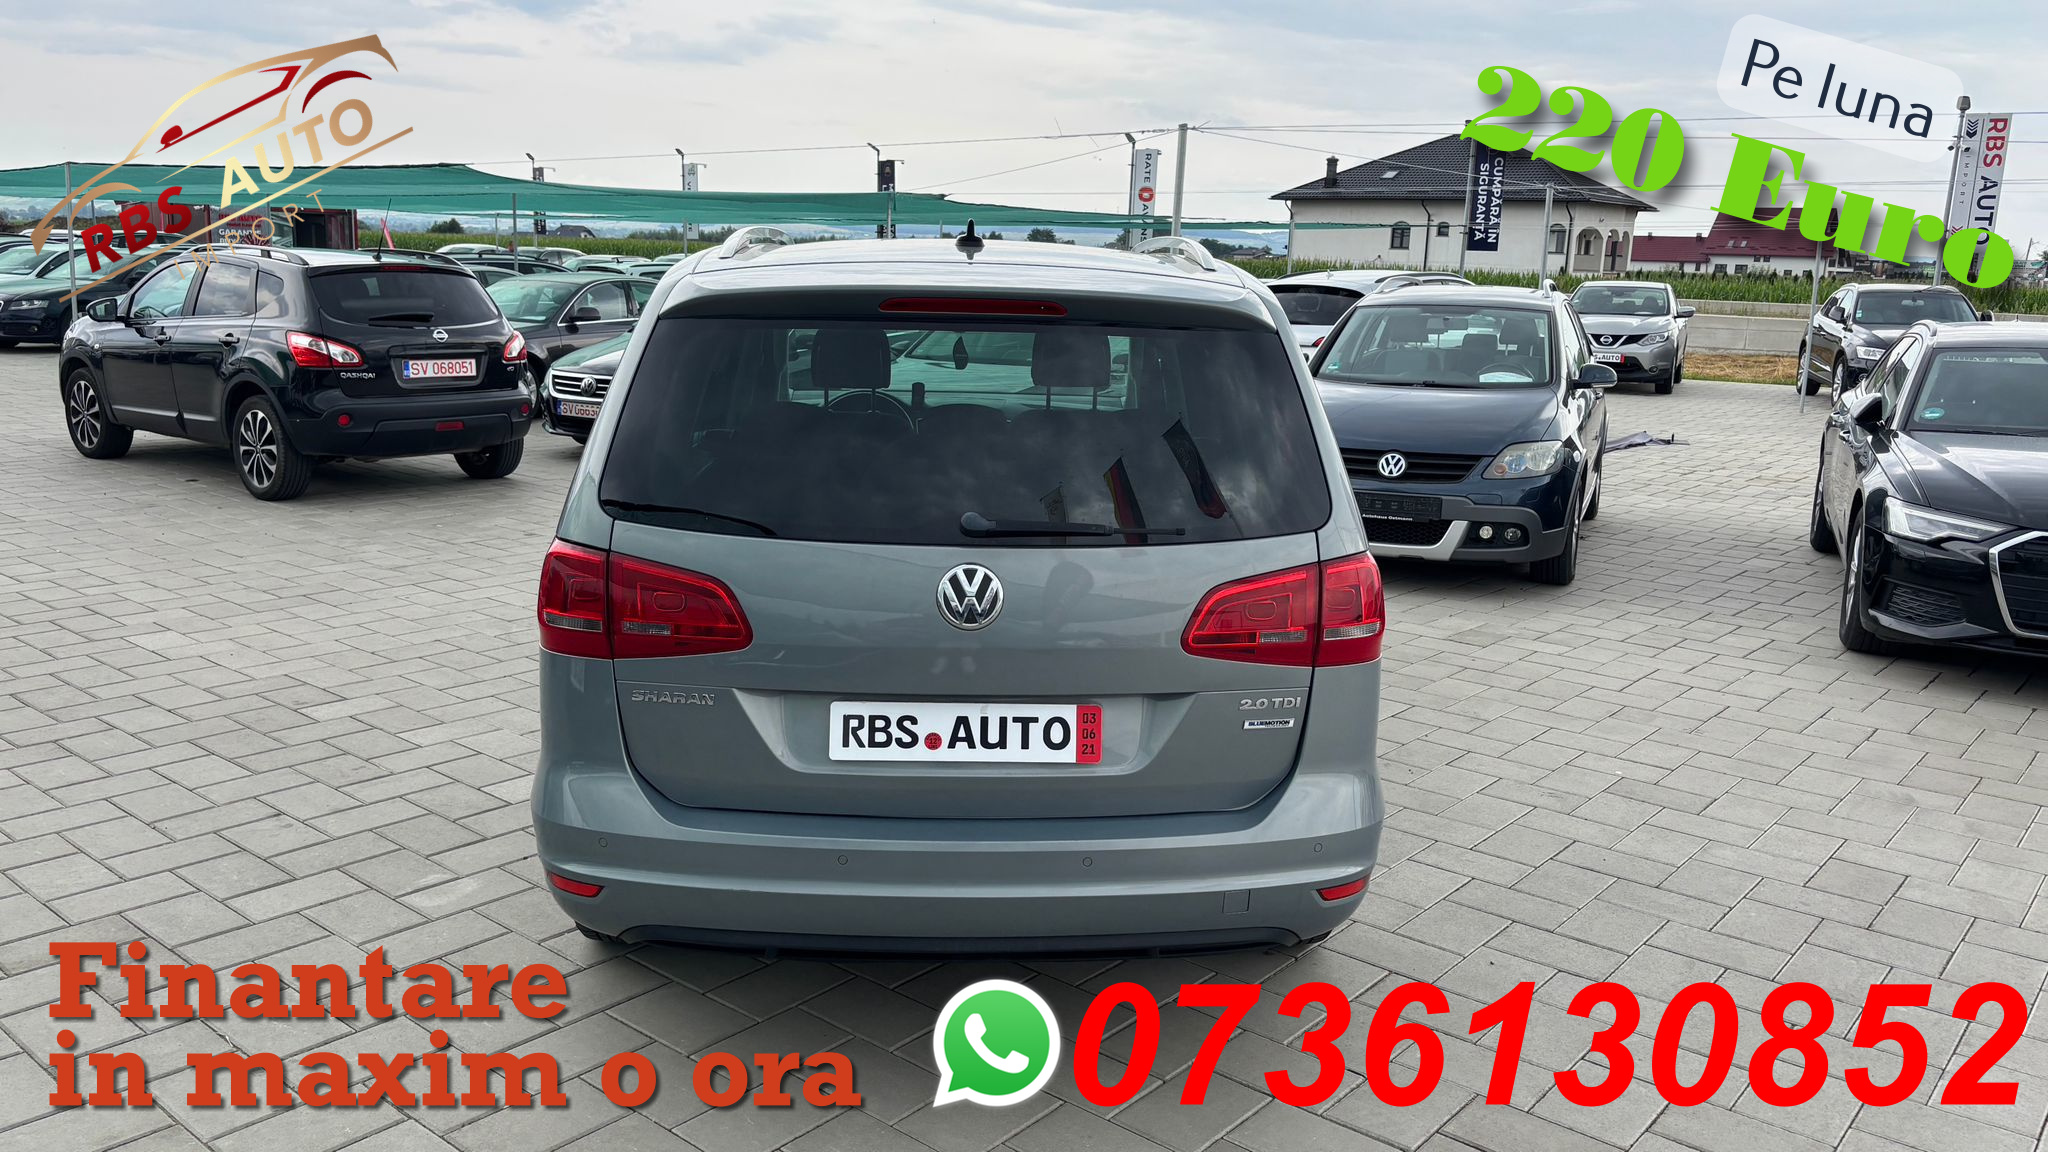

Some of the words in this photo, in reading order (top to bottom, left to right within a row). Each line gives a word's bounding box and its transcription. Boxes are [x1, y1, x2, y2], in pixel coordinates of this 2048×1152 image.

[1983, 118, 2008, 168] RBS
[1143, 153, 1152, 183] RATE
[411, 362, 428, 376] SV
[432, 361, 473, 375] 068051
[562, 402, 574, 414] SV
[631, 689, 715, 705] SHARAN
[1271, 697, 1301, 708] TDI
[1082, 712, 1096, 724] 03
[842, 714, 919, 749] RBS
[947, 716, 1072, 750] AUTO
[1082, 728, 1096, 739] 06
[1082, 743, 1096, 755] 21
